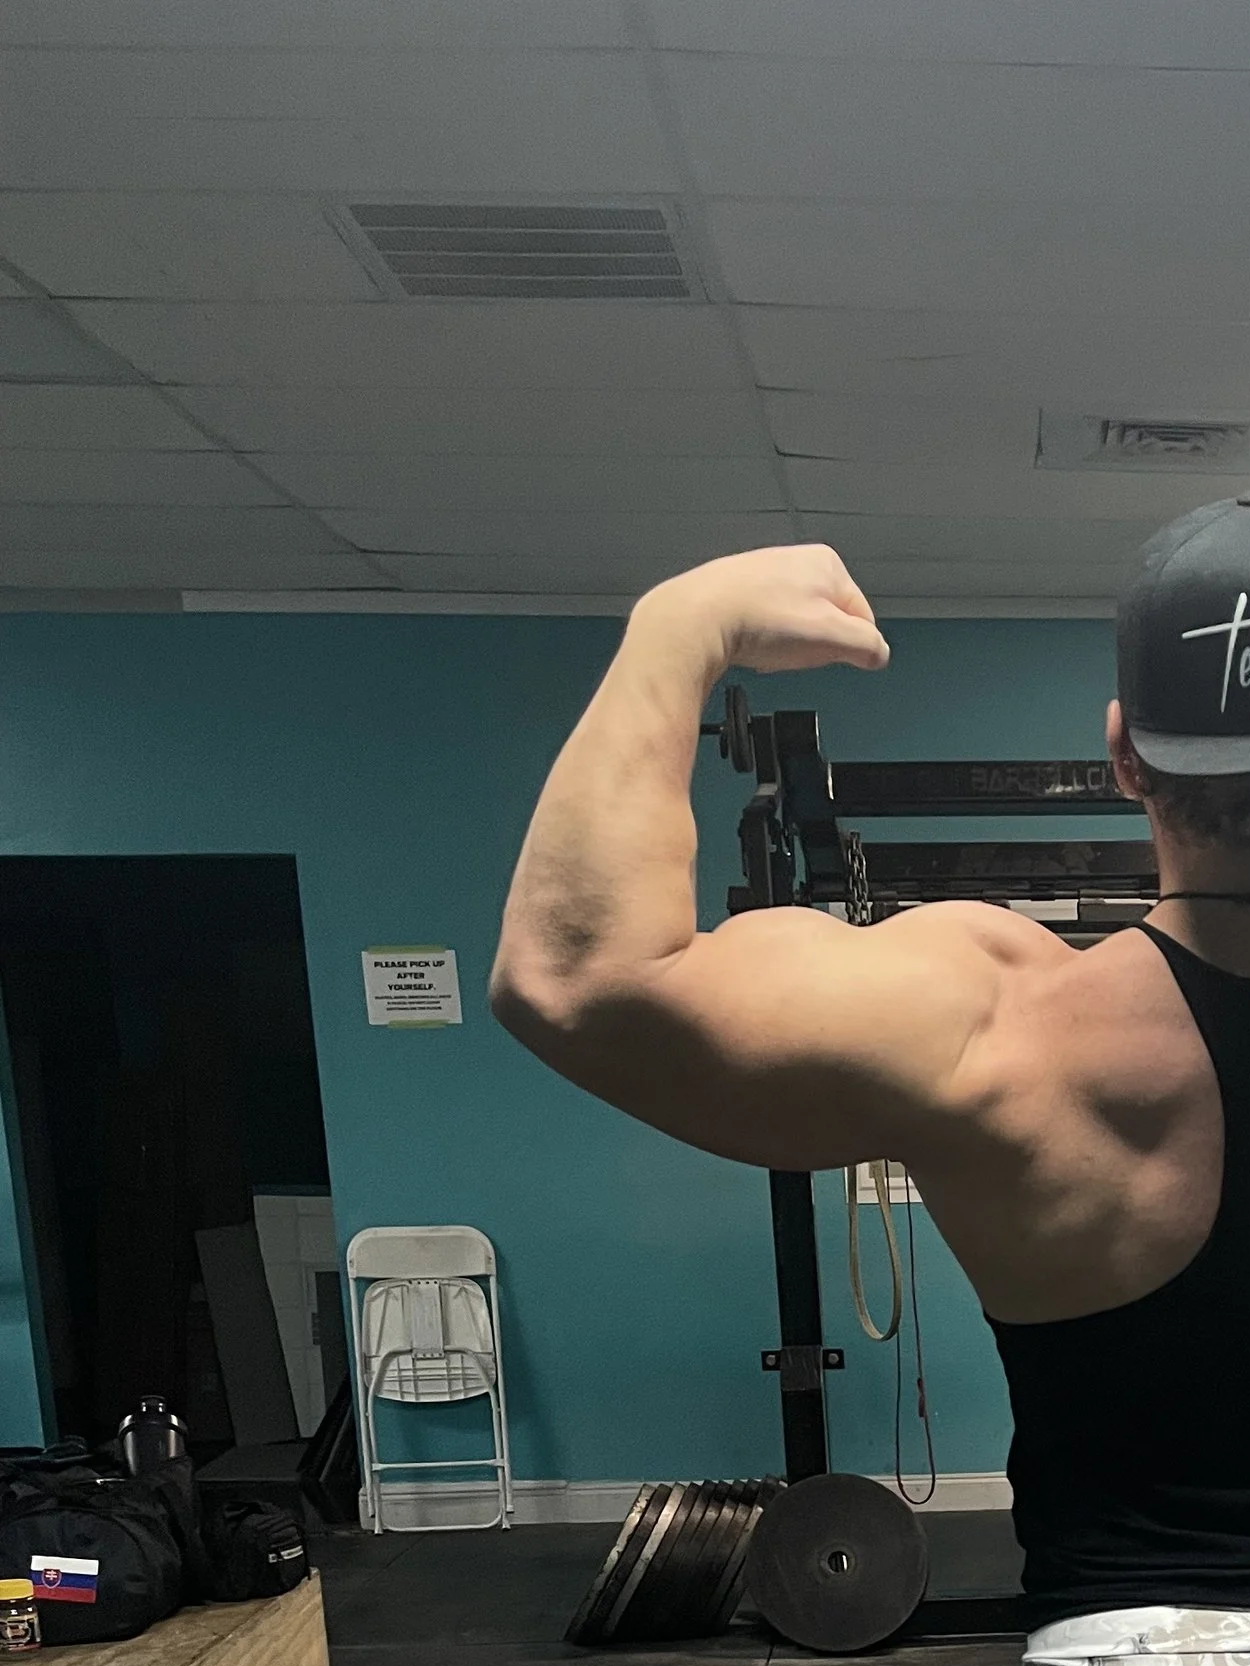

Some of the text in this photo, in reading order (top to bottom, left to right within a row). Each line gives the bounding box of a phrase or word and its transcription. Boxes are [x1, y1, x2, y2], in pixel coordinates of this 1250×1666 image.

[373, 960, 446, 968] PLEASE PICK UP
[396, 972, 426, 980] AFTER
[387, 983, 437, 991] YOURSELF.
